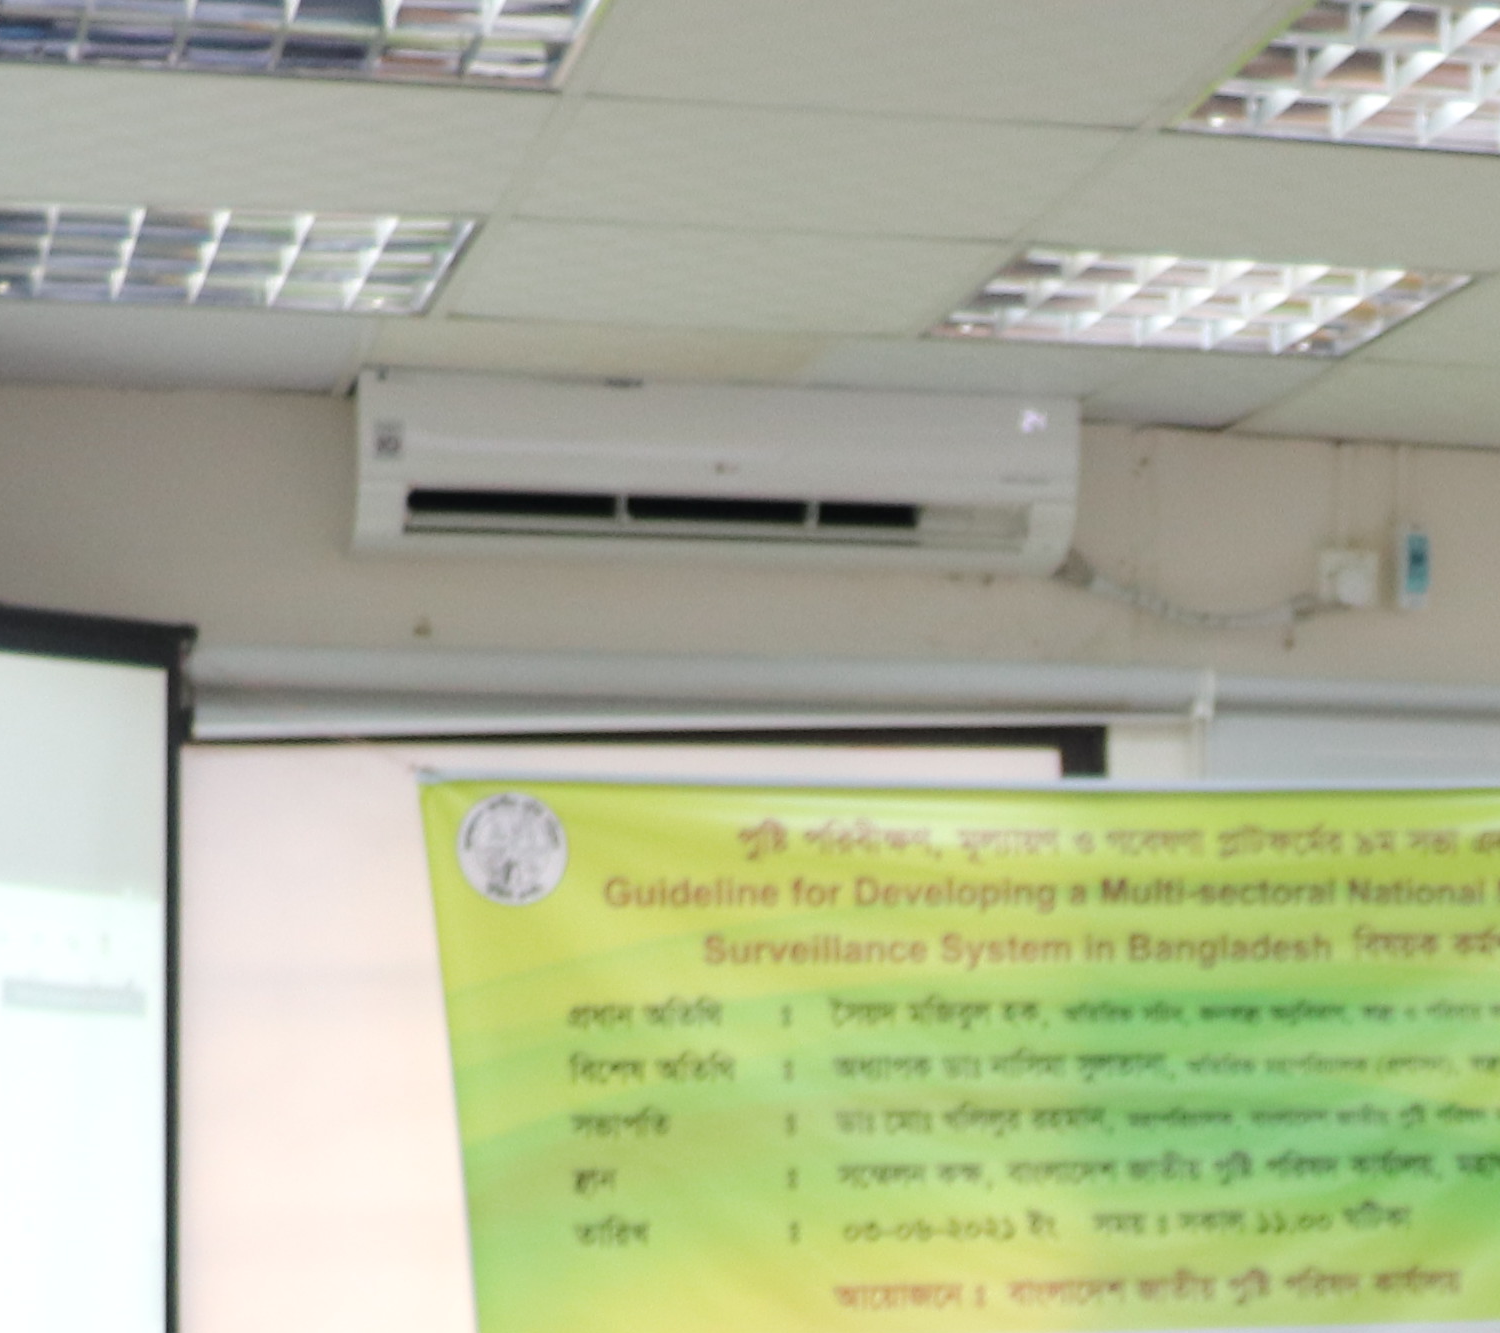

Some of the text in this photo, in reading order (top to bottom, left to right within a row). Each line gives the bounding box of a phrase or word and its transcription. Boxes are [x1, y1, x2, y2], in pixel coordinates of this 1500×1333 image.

[604, 876, 779, 909] Guideline
[792, 876, 841, 906] for
[854, 875, 1056, 914] Developing
[1069, 882, 1088, 905] a
[1102, 876, 1336, 905] Multi-sectoral
[1348, 876, 1485, 905] National
[703, 934, 928, 965] Surveillance
[941, 933, 1072, 971] System
[1085, 934, 1115, 963] in
[1128, 932, 1332, 969] Bangladesh
